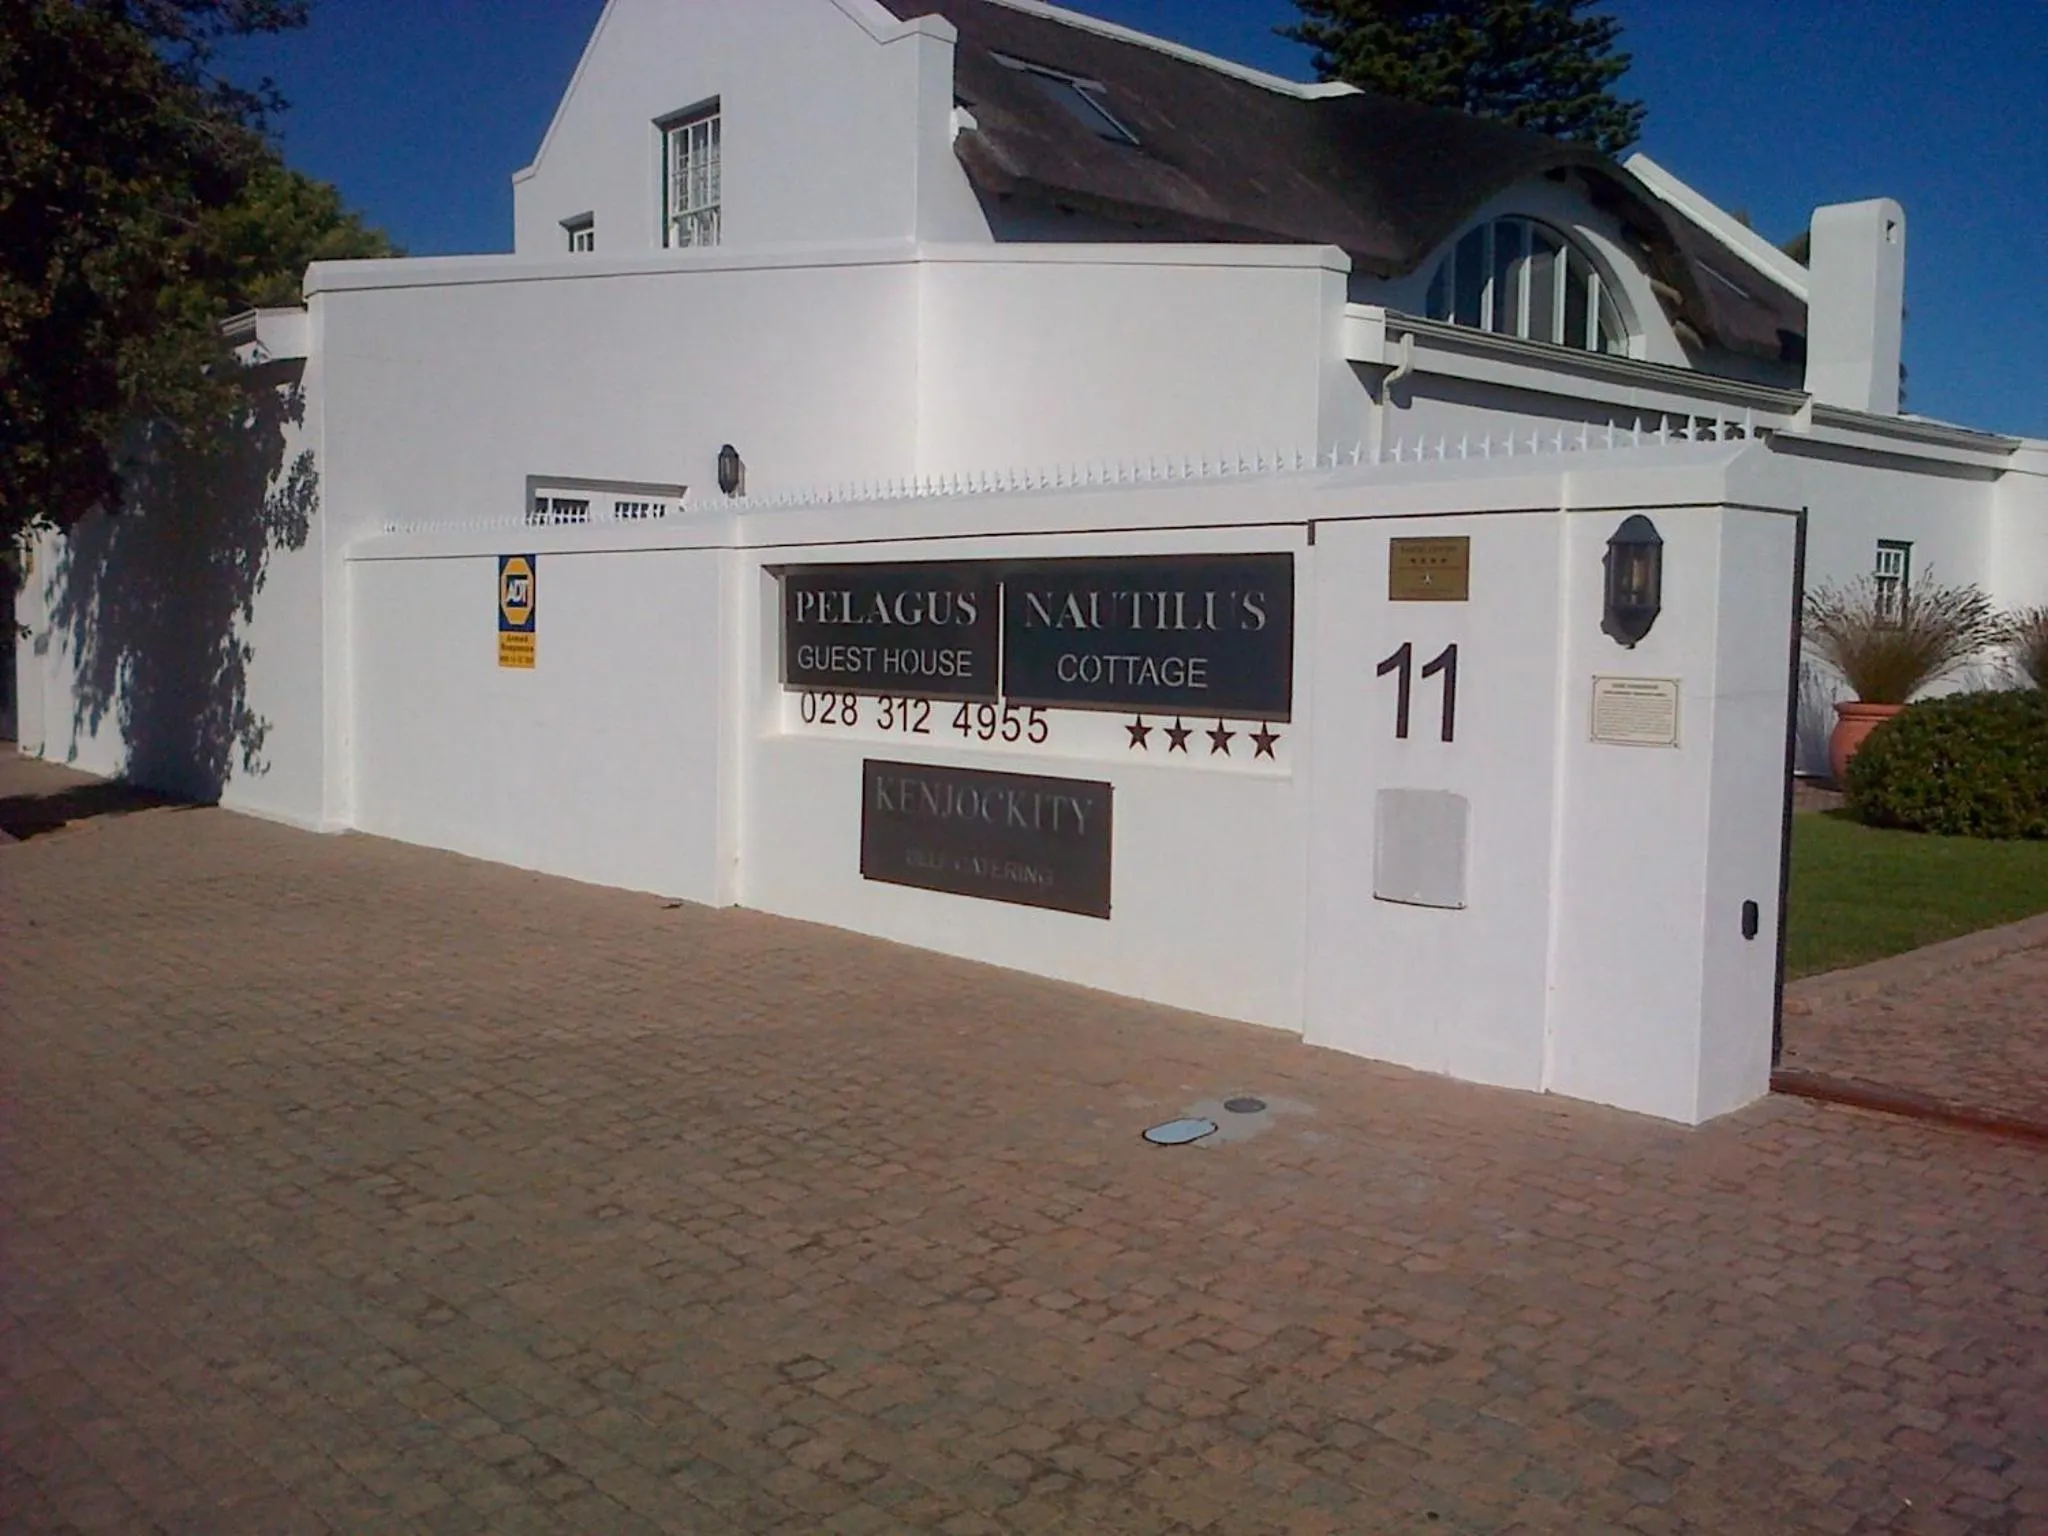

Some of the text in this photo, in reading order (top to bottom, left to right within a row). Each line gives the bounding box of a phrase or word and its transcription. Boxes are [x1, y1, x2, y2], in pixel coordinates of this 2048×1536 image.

[504, 578, 528, 603] ADT
[796, 590, 978, 626] PELAGUS
[1025, 590, 1267, 632] NAUTILUS
[797, 644, 973, 678] GUEST HOUSE
[1057, 653, 1209, 689] COTTAGE
[1376, 641, 1458, 742] 11
[801, 690, 1049, 745] 028 312 4955
[875, 775, 1093, 836] KENJOCKITY
